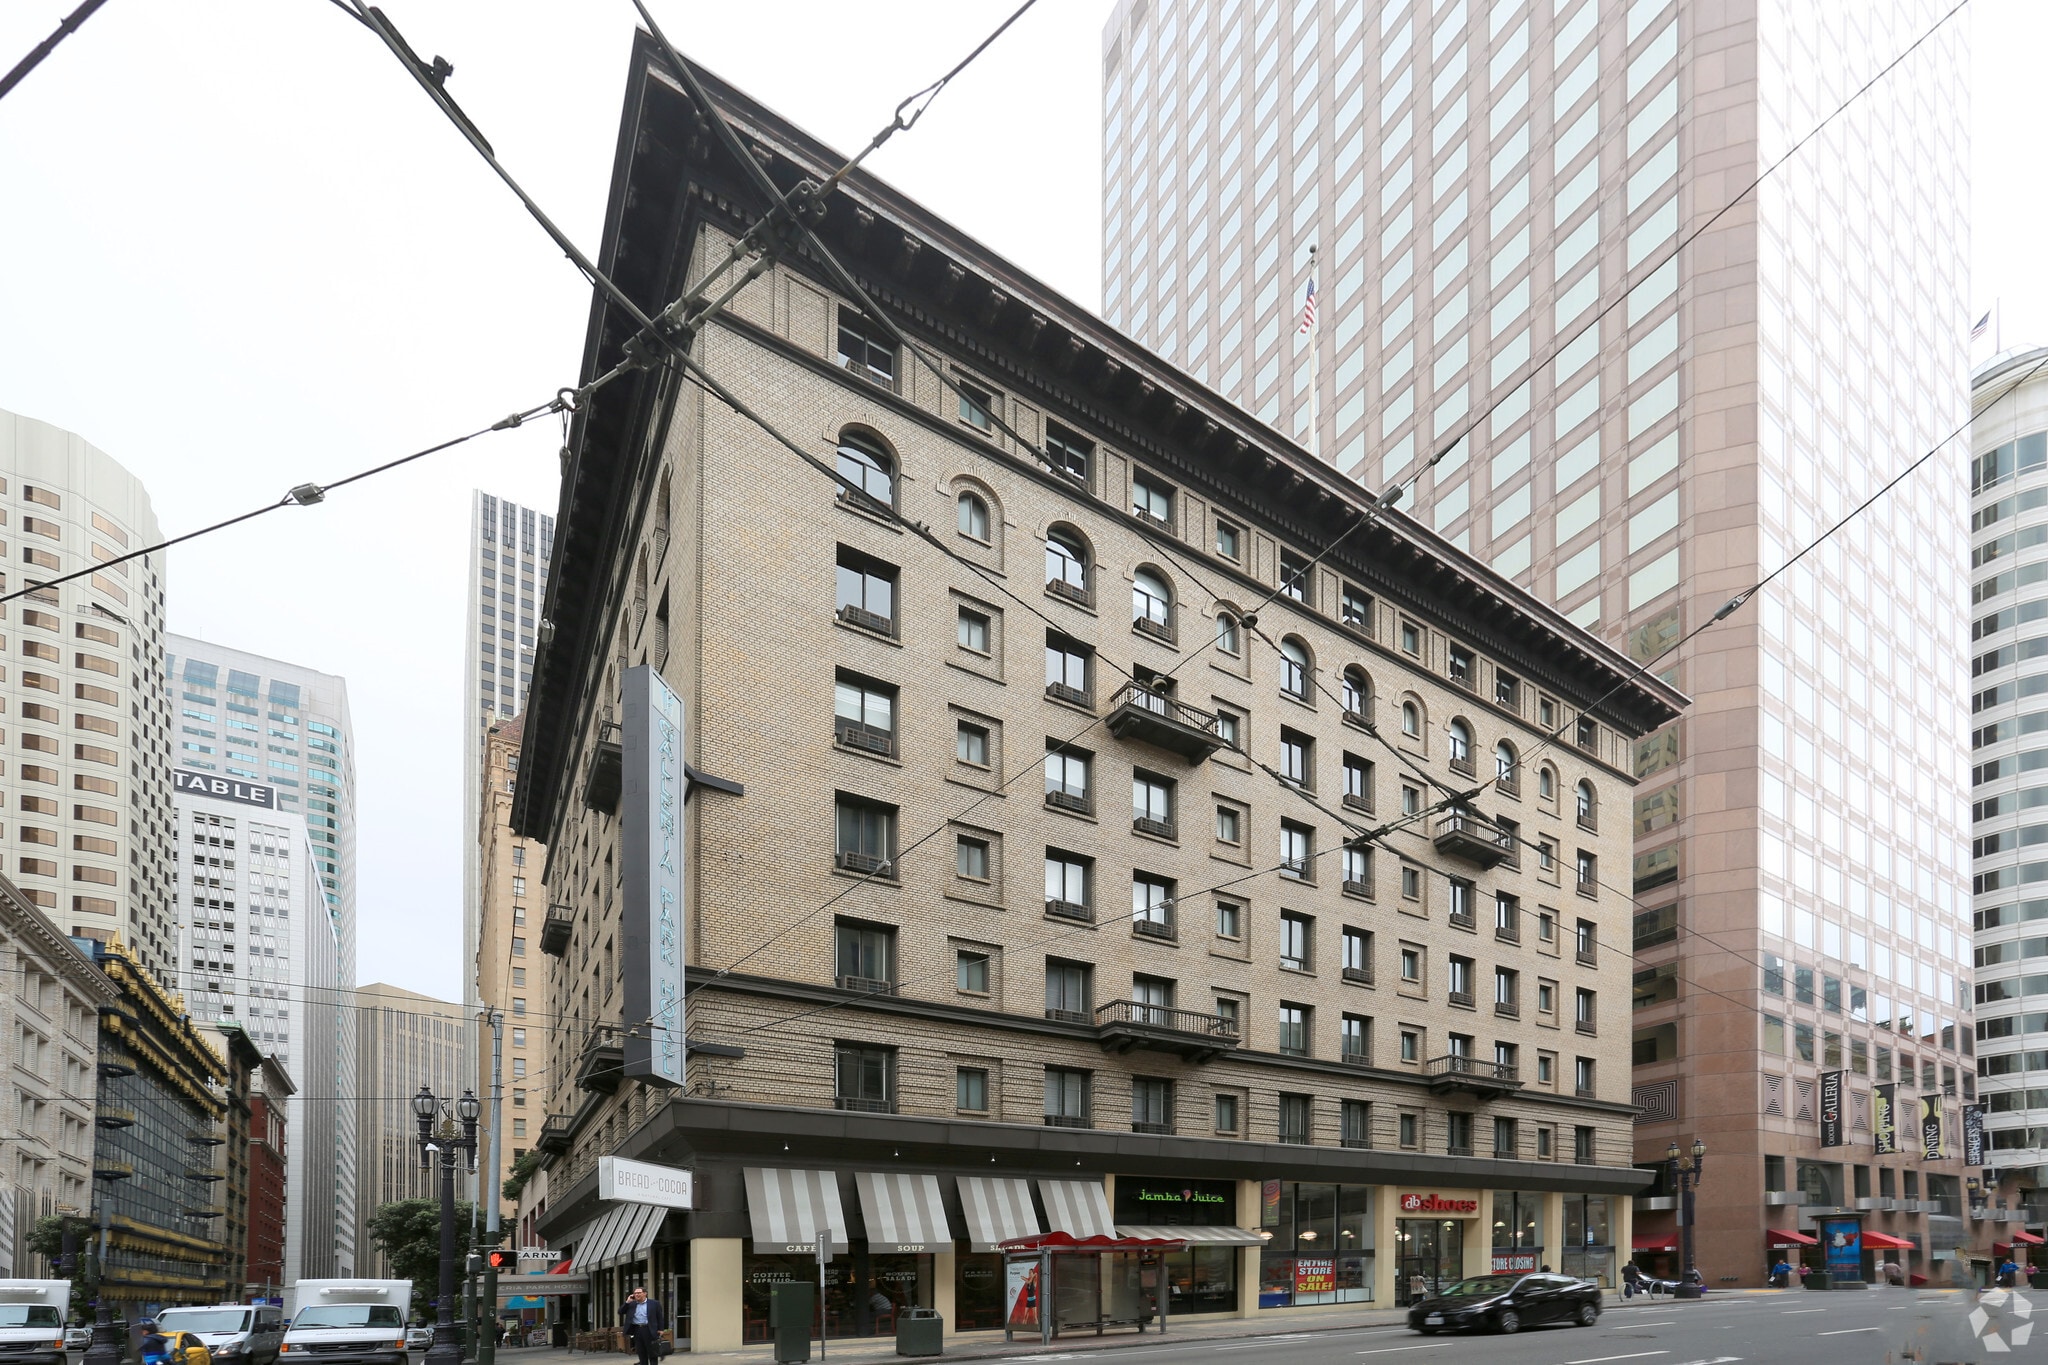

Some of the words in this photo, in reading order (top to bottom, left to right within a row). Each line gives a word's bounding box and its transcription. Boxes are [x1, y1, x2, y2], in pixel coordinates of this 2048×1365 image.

[173, 772, 266, 803] TABLE
[659, 885, 675, 968] PARK
[659, 977, 677, 1076] HOTEL
[1822, 1073, 1838, 1123] GALLERIA
[1926, 1124, 1940, 1160] DINING
[618, 1170, 650, 1190] BREAD
[658, 1177, 687, 1196] COCOA
[1420, 1194, 1478, 1212] shoes
[1298, 1267, 1332, 1275] STORE
[1297, 1282, 1333, 1292] SALE!
